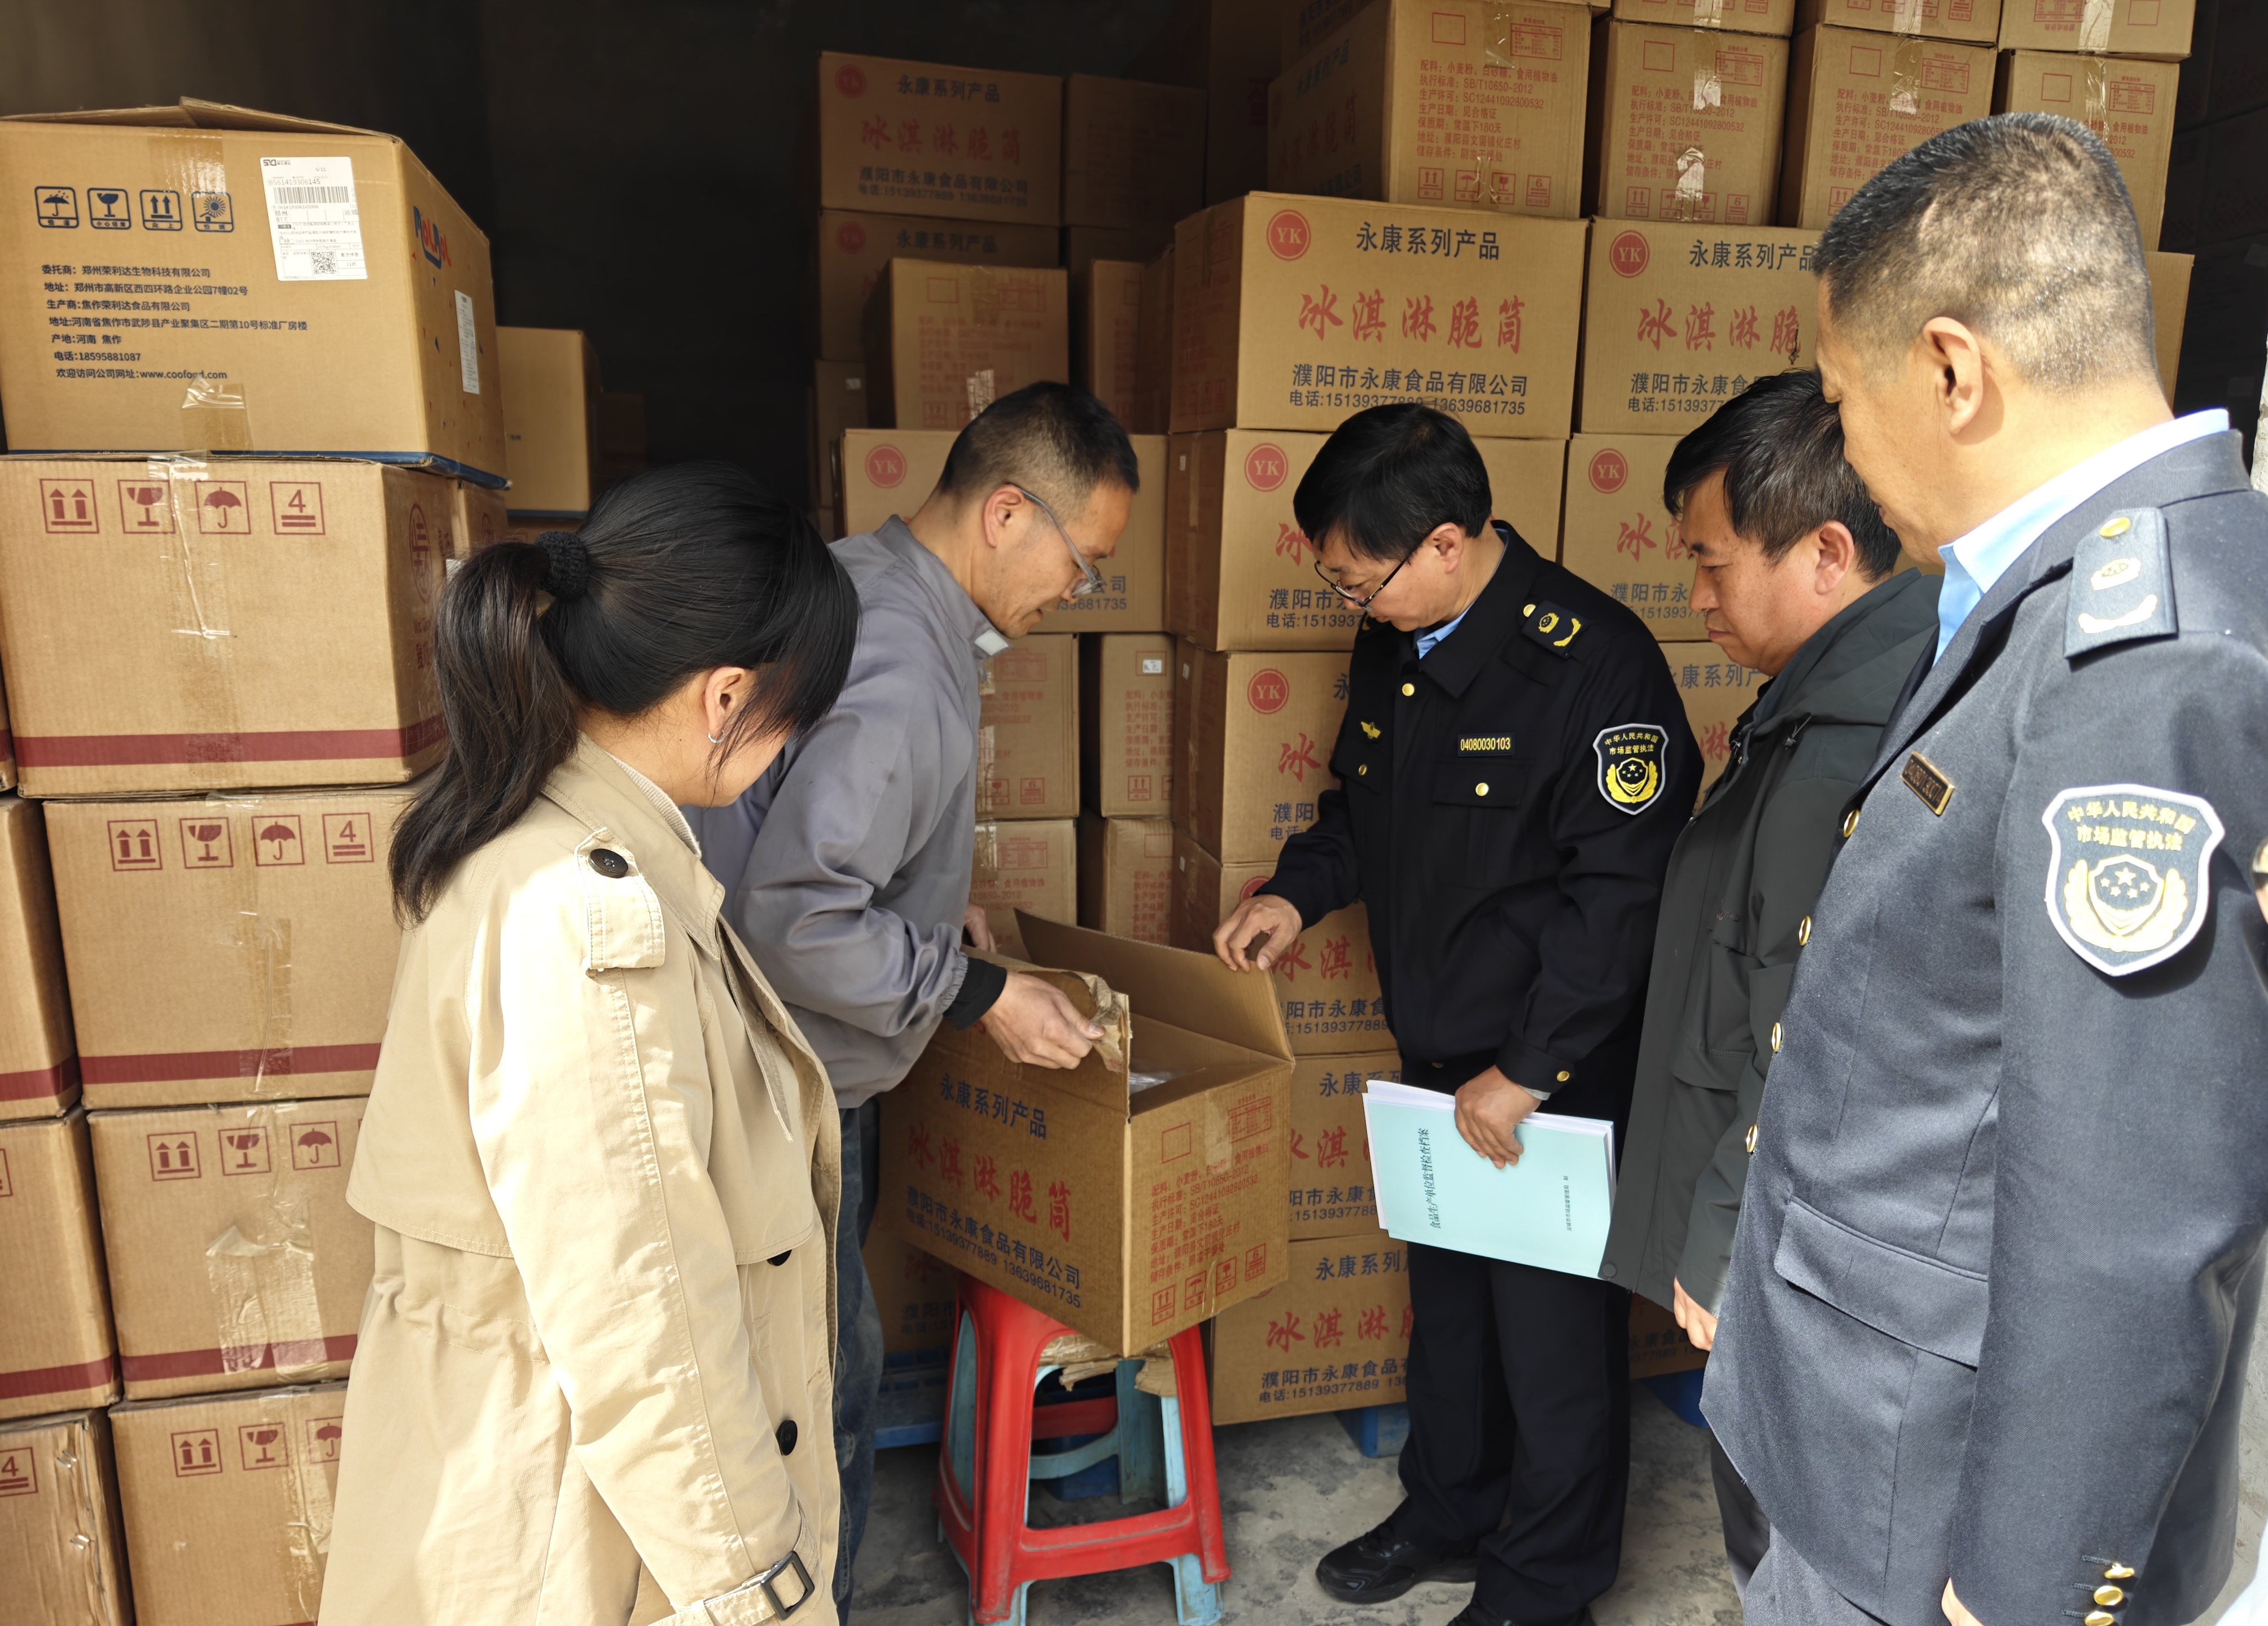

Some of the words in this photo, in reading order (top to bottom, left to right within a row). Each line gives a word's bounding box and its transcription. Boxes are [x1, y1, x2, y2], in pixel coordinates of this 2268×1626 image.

[897, 74, 1000, 103] 永康系列产品
[1631, 85, 1758, 108] 配料：小麦粉、白食用植物油
[860, 115, 1022, 166] 冰淇淋脆筒
[1535, 178, 1543, 188] 6
[1734, 198, 1742, 207] 6
[896, 229, 997, 254] 永康系列产品
[1275, 227, 1303, 245] YK
[1355, 221, 1500, 261] 永康系列产品
[1618, 247, 1642, 264] YK
[1689, 239, 1817, 271] 永康系列产品
[1298, 284, 1526, 355] 冰淇淋脆筒
[102, 334, 122, 345] 焦作
[1291, 363, 1529, 397] 濮阳市永康食品有限公司
[1630, 372, 1761, 396] 濮阳市永康食
[1432, 396, 1526, 416] 13639681735
[873, 458, 897, 475] YK
[1254, 460, 1280, 477] YK
[1596, 464, 1621, 480] YK
[288, 489, 306, 513] 4
[1670, 664, 1767, 689] 康系列产
[1256, 685, 1281, 700] YK
[1459, 737, 1511, 752] 04080030103
[1604, 731, 1659, 747] 中华人民共和国
[1608, 744, 1654, 756] 市场监管执法
[1272, 803, 1315, 824] 濮阳
[2067, 800, 2196, 835] 中华人民共和国
[339, 820, 357, 844] 4
[2076, 825, 2183, 851] 市场监管执法
[1272, 935, 1376, 983] 冰淇
[1284, 995, 1385, 1020] 阳市永康食
[939, 1073, 1047, 1140] 永康系列产品
[908, 1121, 1071, 1242] 冰淇淋脆筒
[1417, 1128, 1442, 1229] 食品生产单位监督检查档案
[906, 1186, 1081, 1291] 濮阳市永康食品有限公司
[1253, 1250, 1259, 1260] 6
[1315, 1251, 1408, 1281] 永康系列
[1002, 1258, 1081, 1308] 13639681735
[1259, 1378, 1379, 1404] 电话:15139377889
